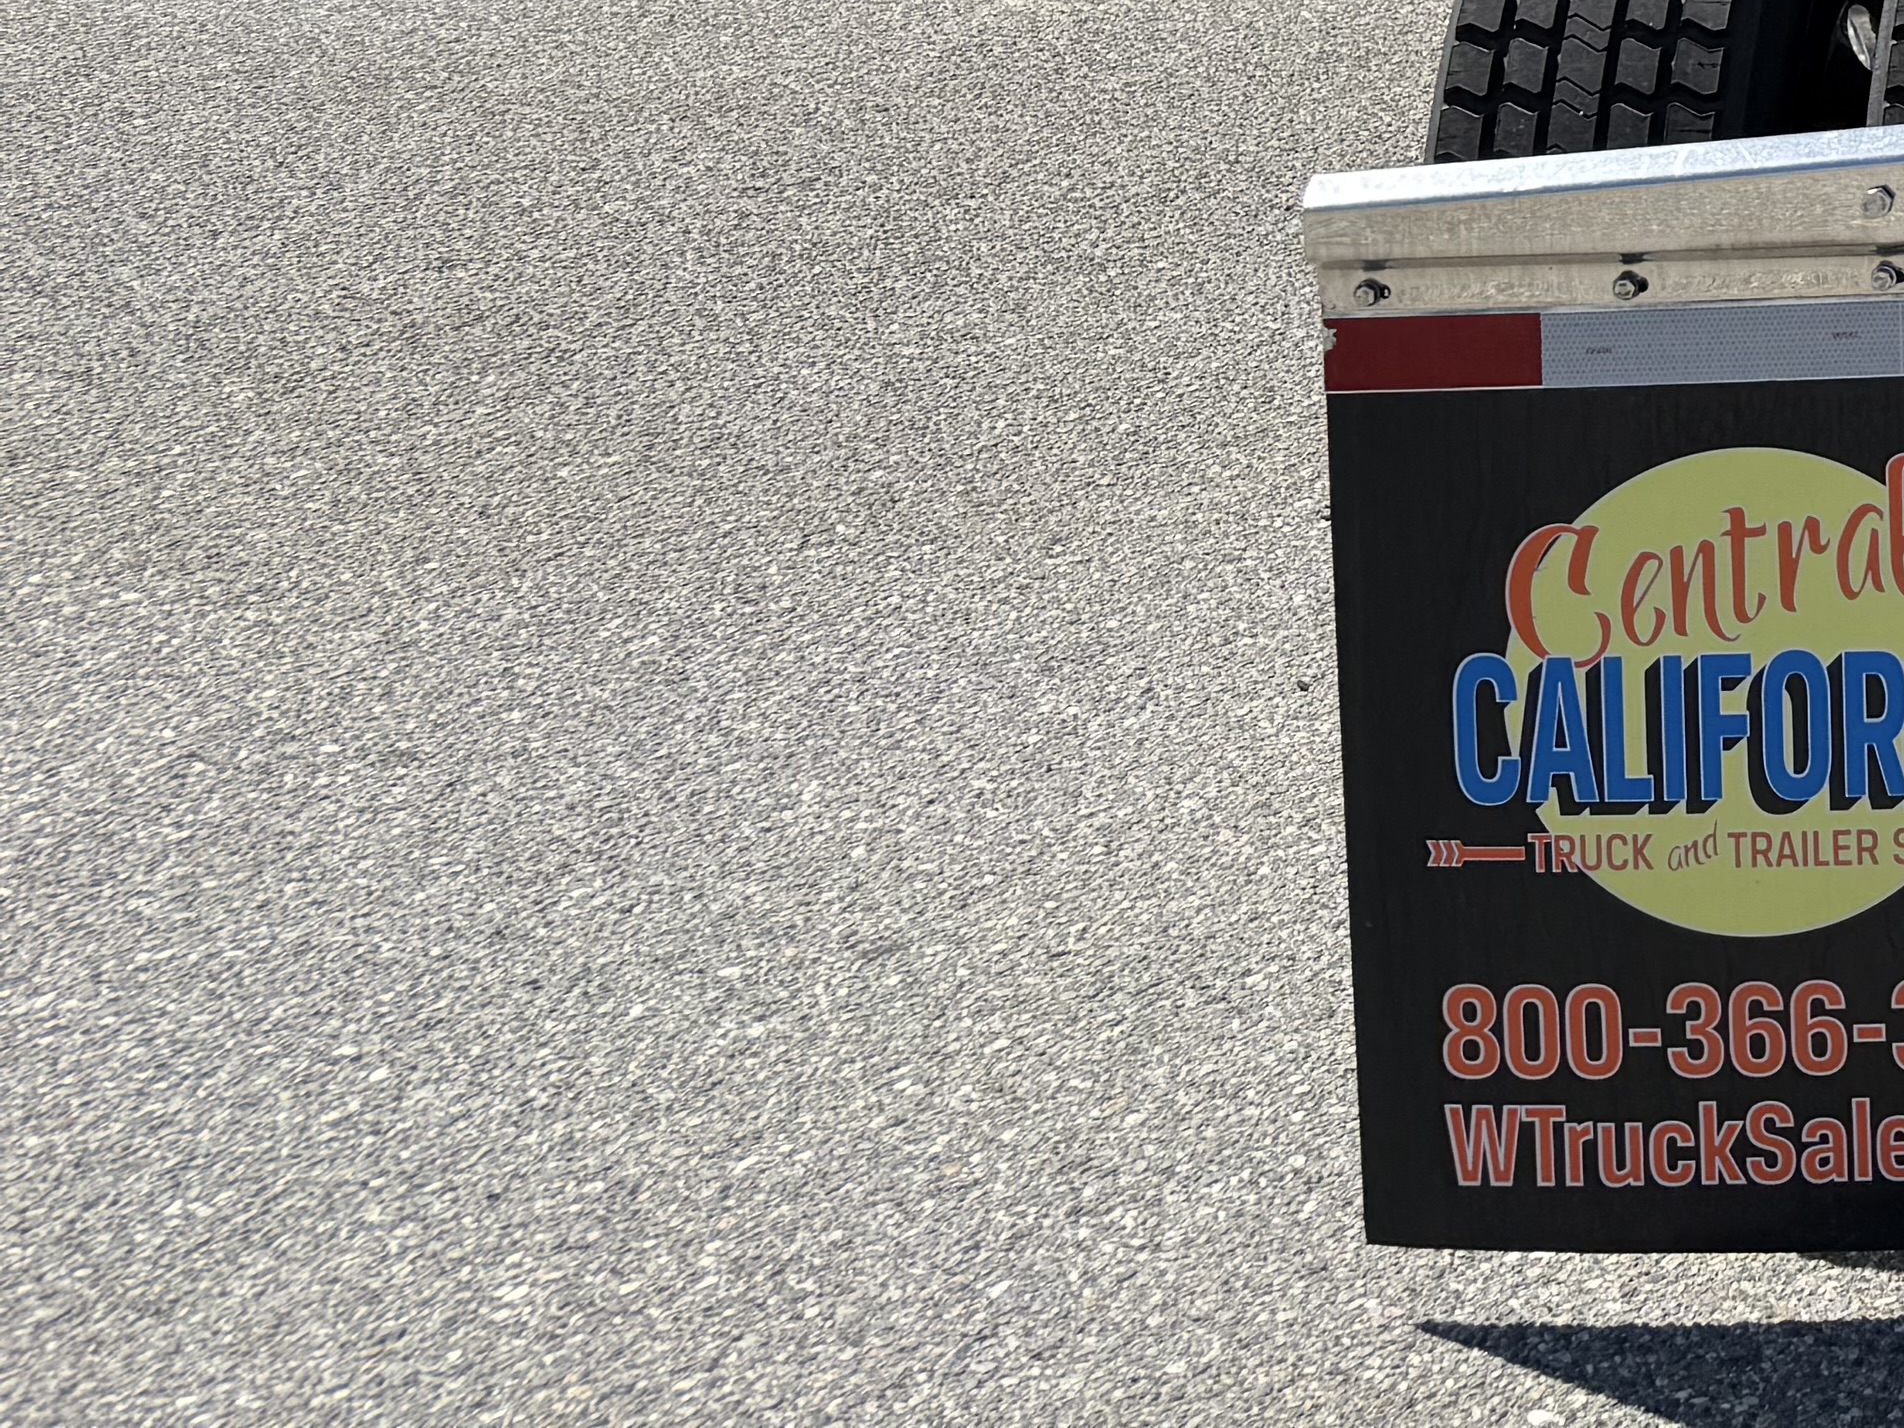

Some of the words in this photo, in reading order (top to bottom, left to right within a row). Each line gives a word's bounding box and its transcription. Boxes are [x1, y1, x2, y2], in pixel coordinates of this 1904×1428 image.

[1527, 832, 1655, 874] TRUCK
[1666, 820, 1721, 873] and
[1727, 827, 1880, 869] TRAILER
